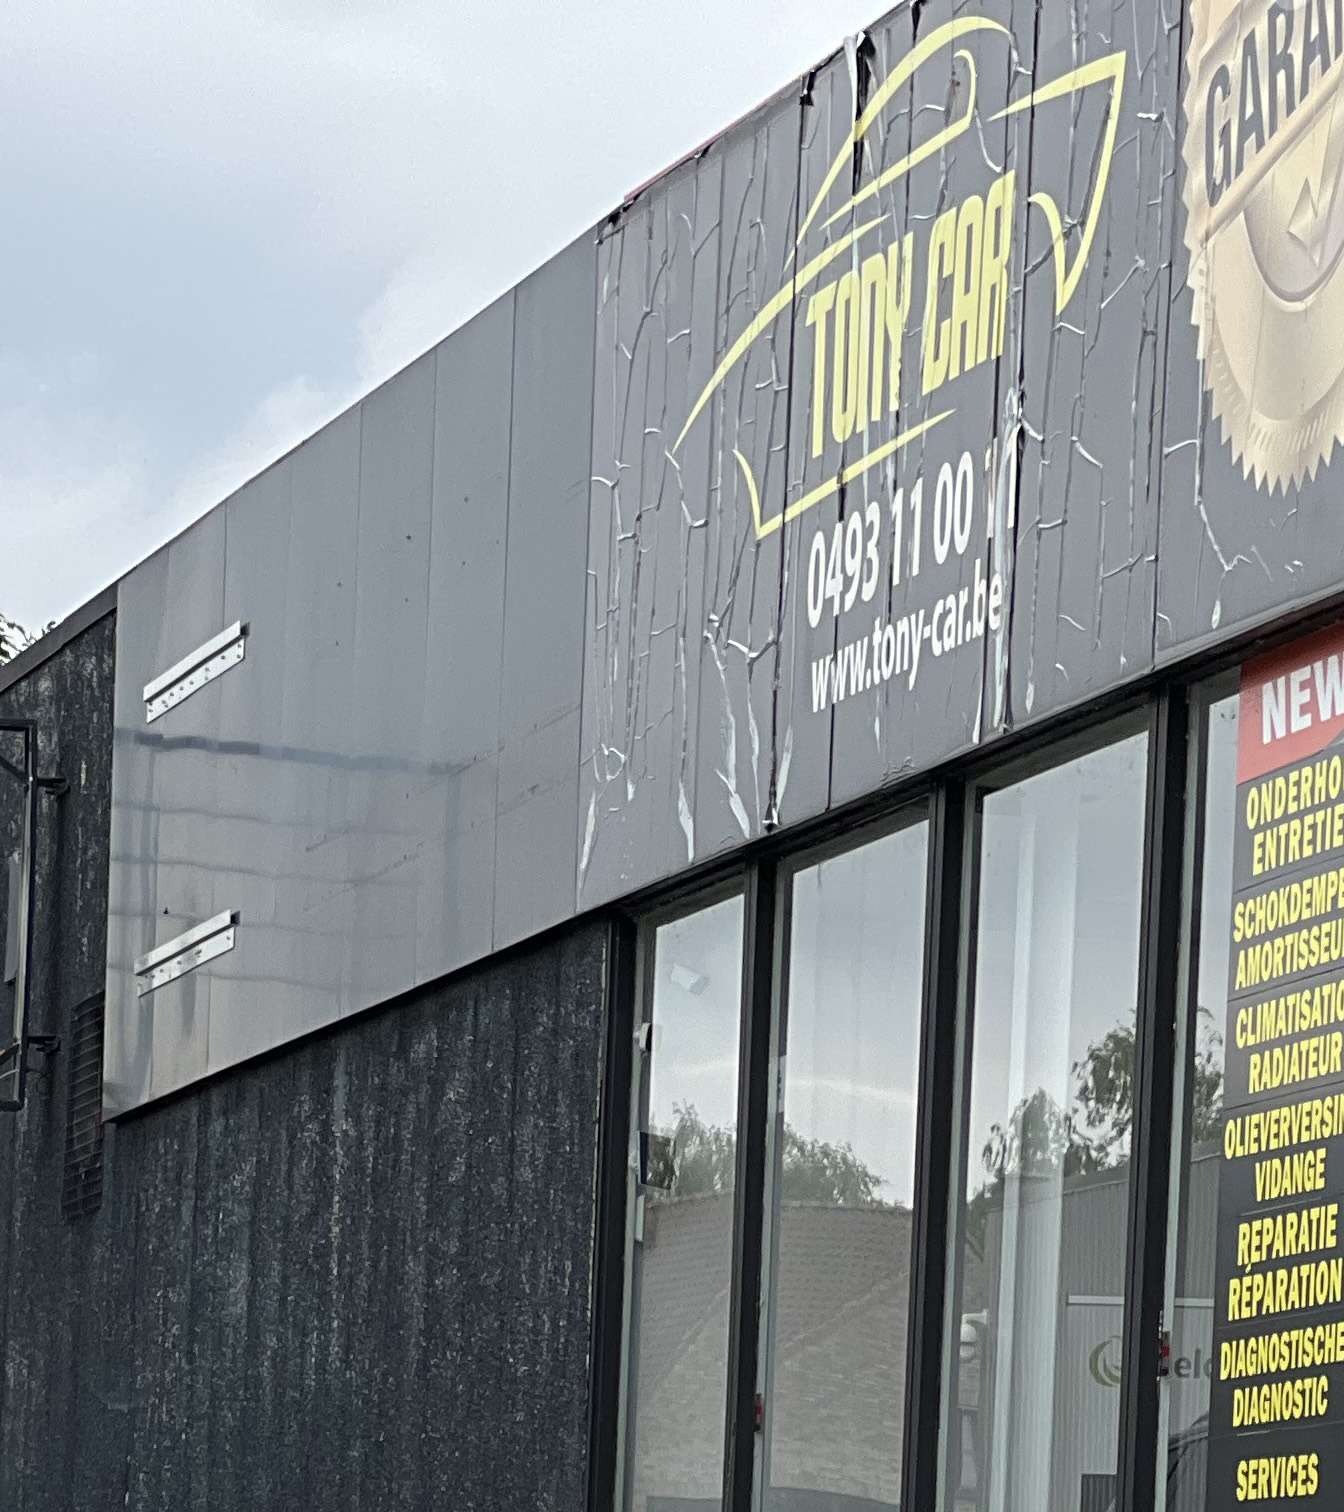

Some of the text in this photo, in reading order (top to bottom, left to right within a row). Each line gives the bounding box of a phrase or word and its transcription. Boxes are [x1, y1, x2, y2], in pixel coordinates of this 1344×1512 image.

[805, 169, 1015, 458] TONY CAR
[807, 501, 881, 628] 0493
[892, 476, 924, 586] 11
[933, 451, 974, 564] 00
[811, 558, 1003, 713] www.tony-car.be
[1248, 1033, 1343, 1094] RADIATEUR
[1254, 1149, 1326, 1202] VIDANGE
[1236, 1203, 1339, 1267] REPARATIE
[1228, 1257, 1344, 1322] RÉPARATION
[1232, 1375, 1329, 1428] DIAGNOSTIC
[1236, 1453, 1320, 1502] SERVICES
